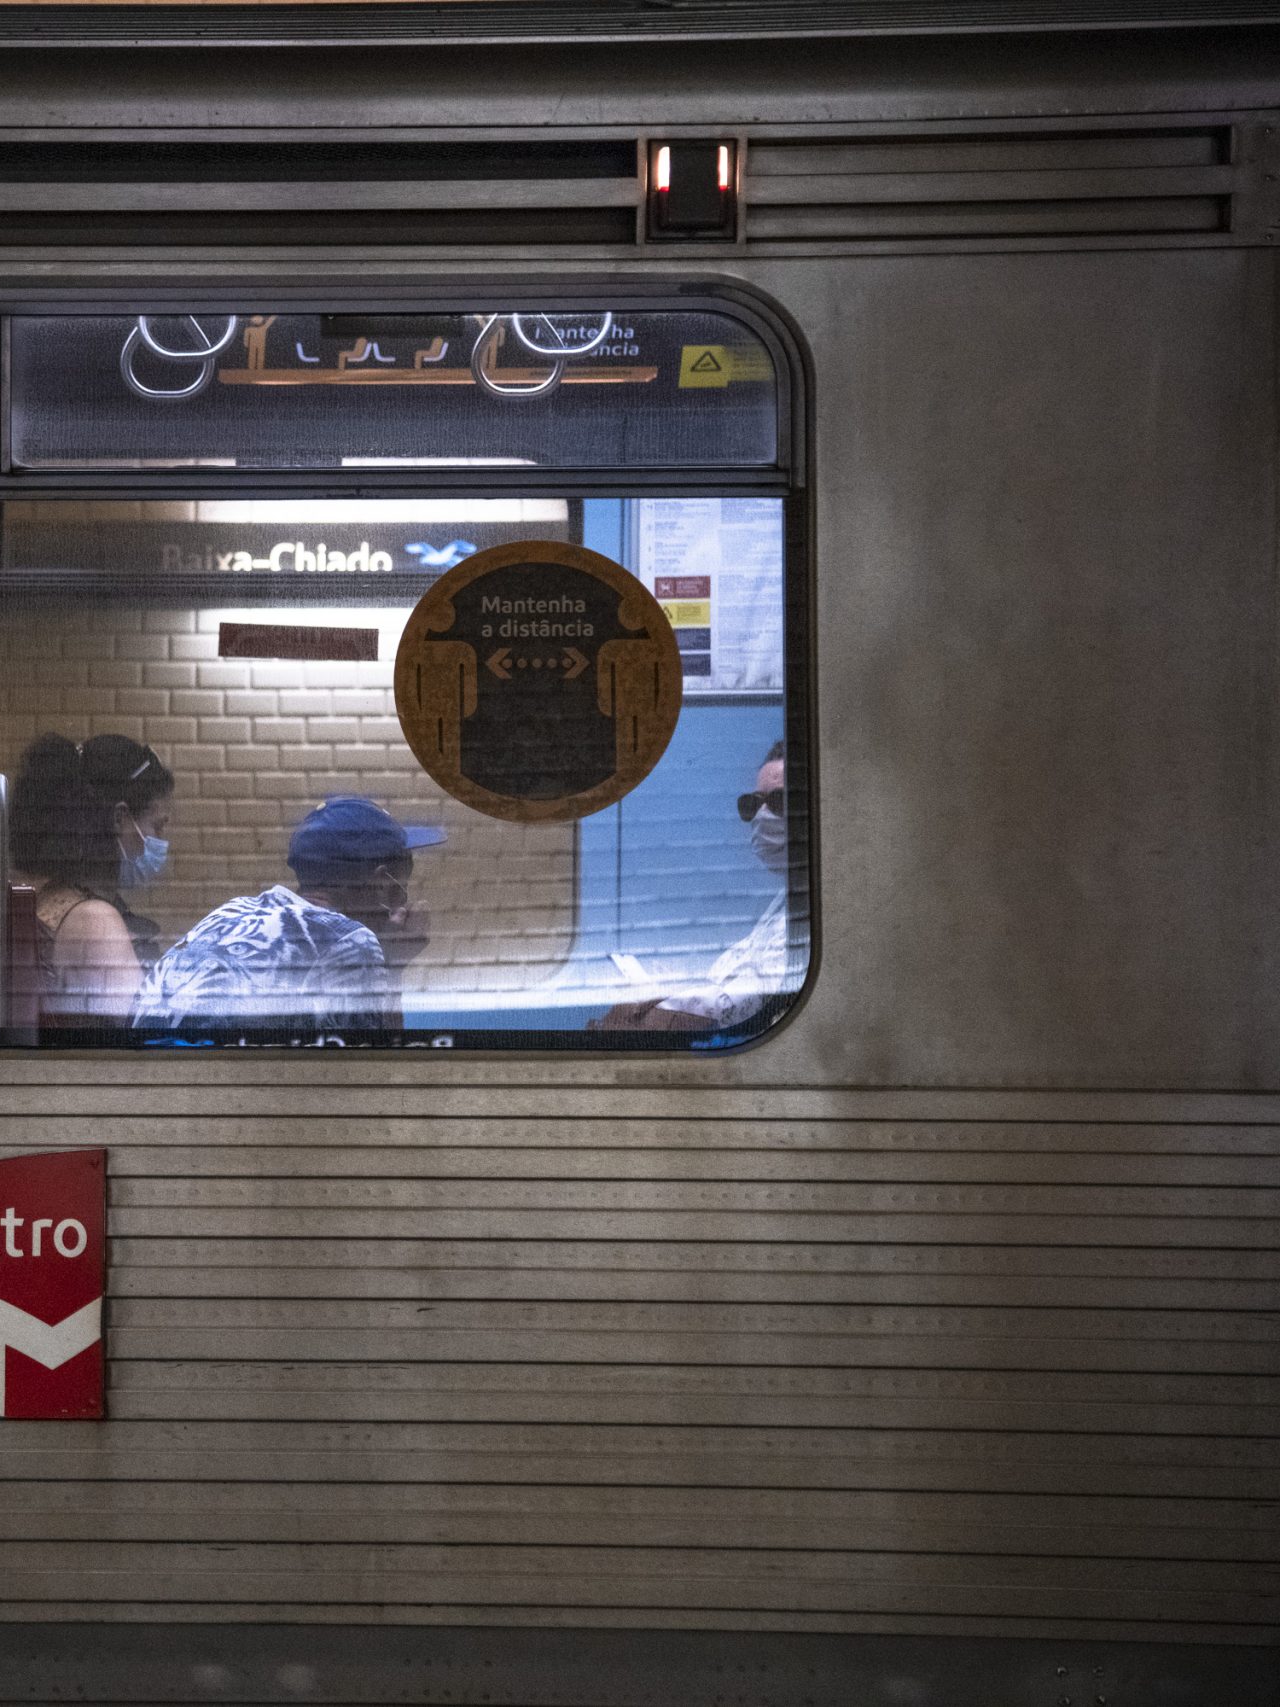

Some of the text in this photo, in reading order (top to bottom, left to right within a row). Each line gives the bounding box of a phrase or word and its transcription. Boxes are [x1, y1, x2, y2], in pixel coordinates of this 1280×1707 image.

[481, 595, 586, 614] Mantenha
[481, 619, 595, 638] a distância
